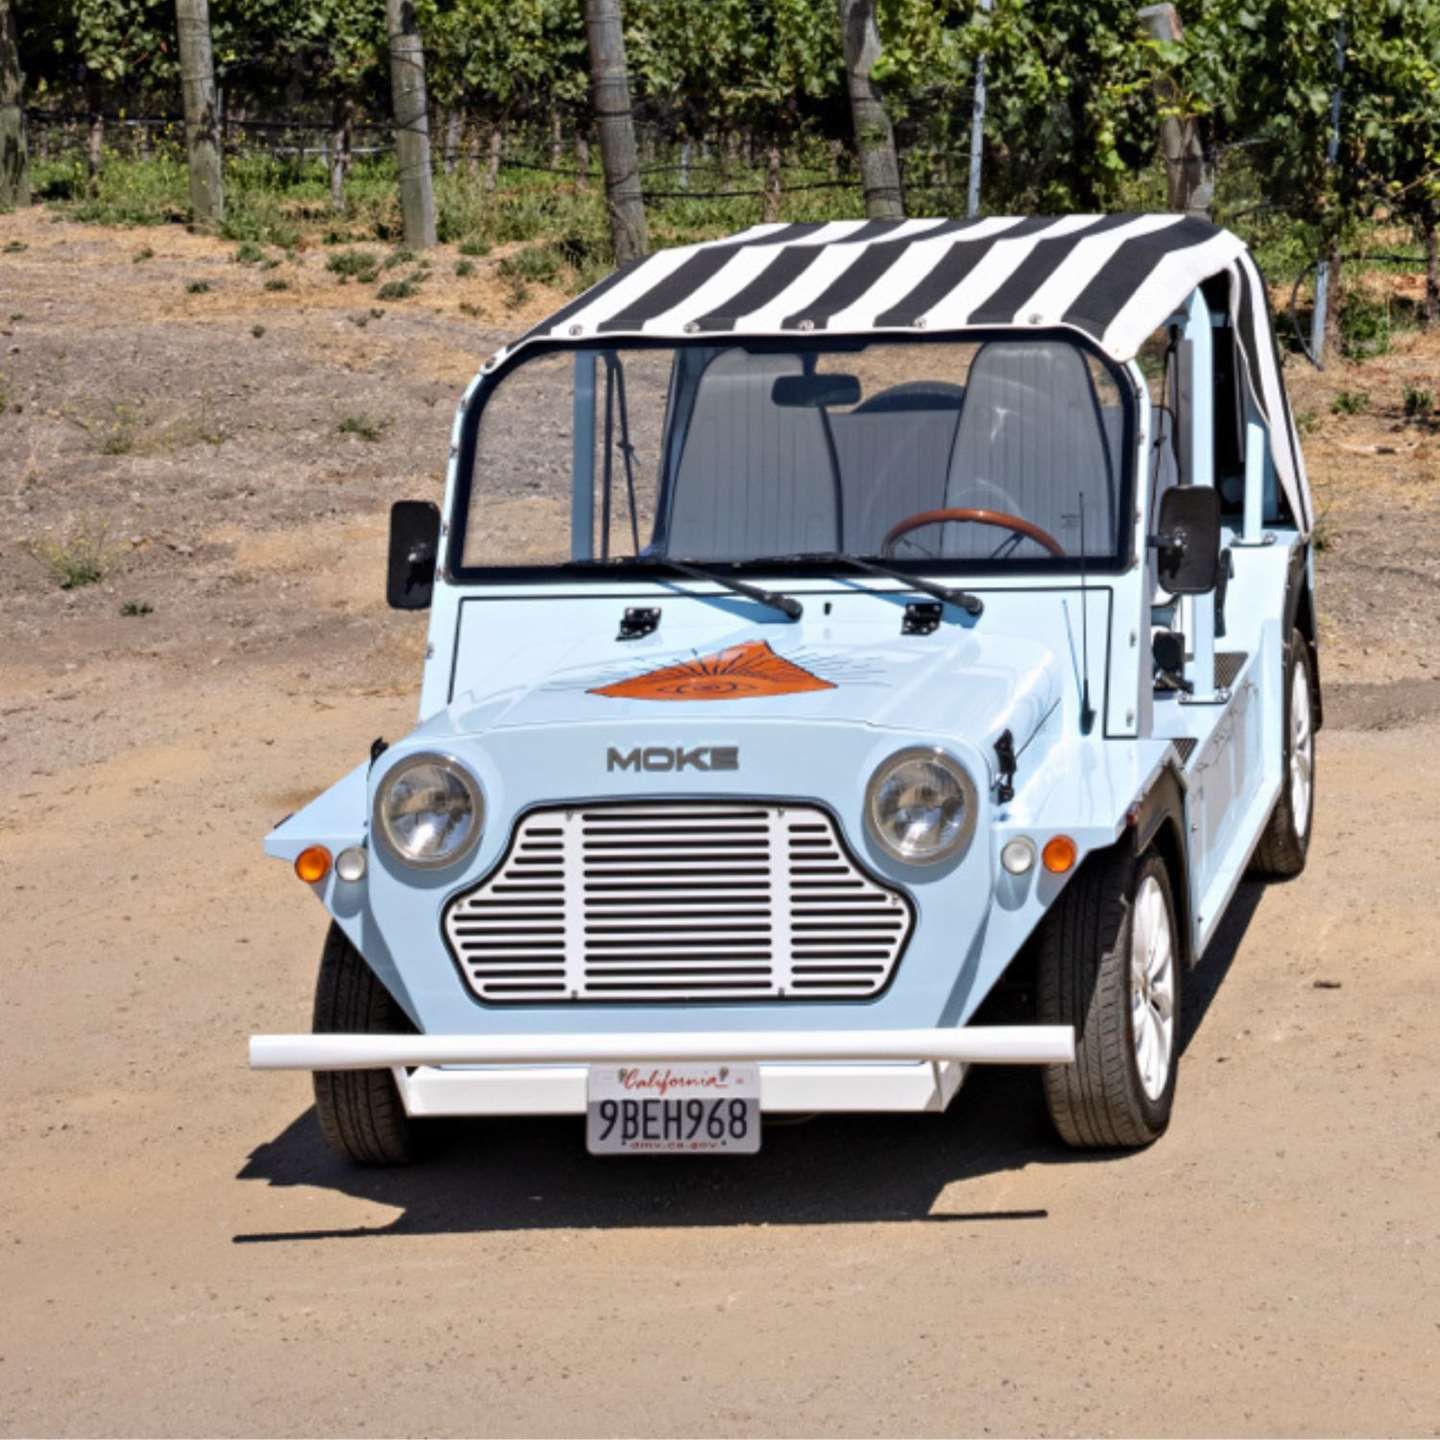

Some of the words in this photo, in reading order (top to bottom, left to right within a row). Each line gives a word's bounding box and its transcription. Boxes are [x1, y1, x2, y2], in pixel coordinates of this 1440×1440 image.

[607, 746, 739, 772] MOKE
[624, 1068, 728, 1095] California
[599, 1098, 748, 1141] 9BEH968
